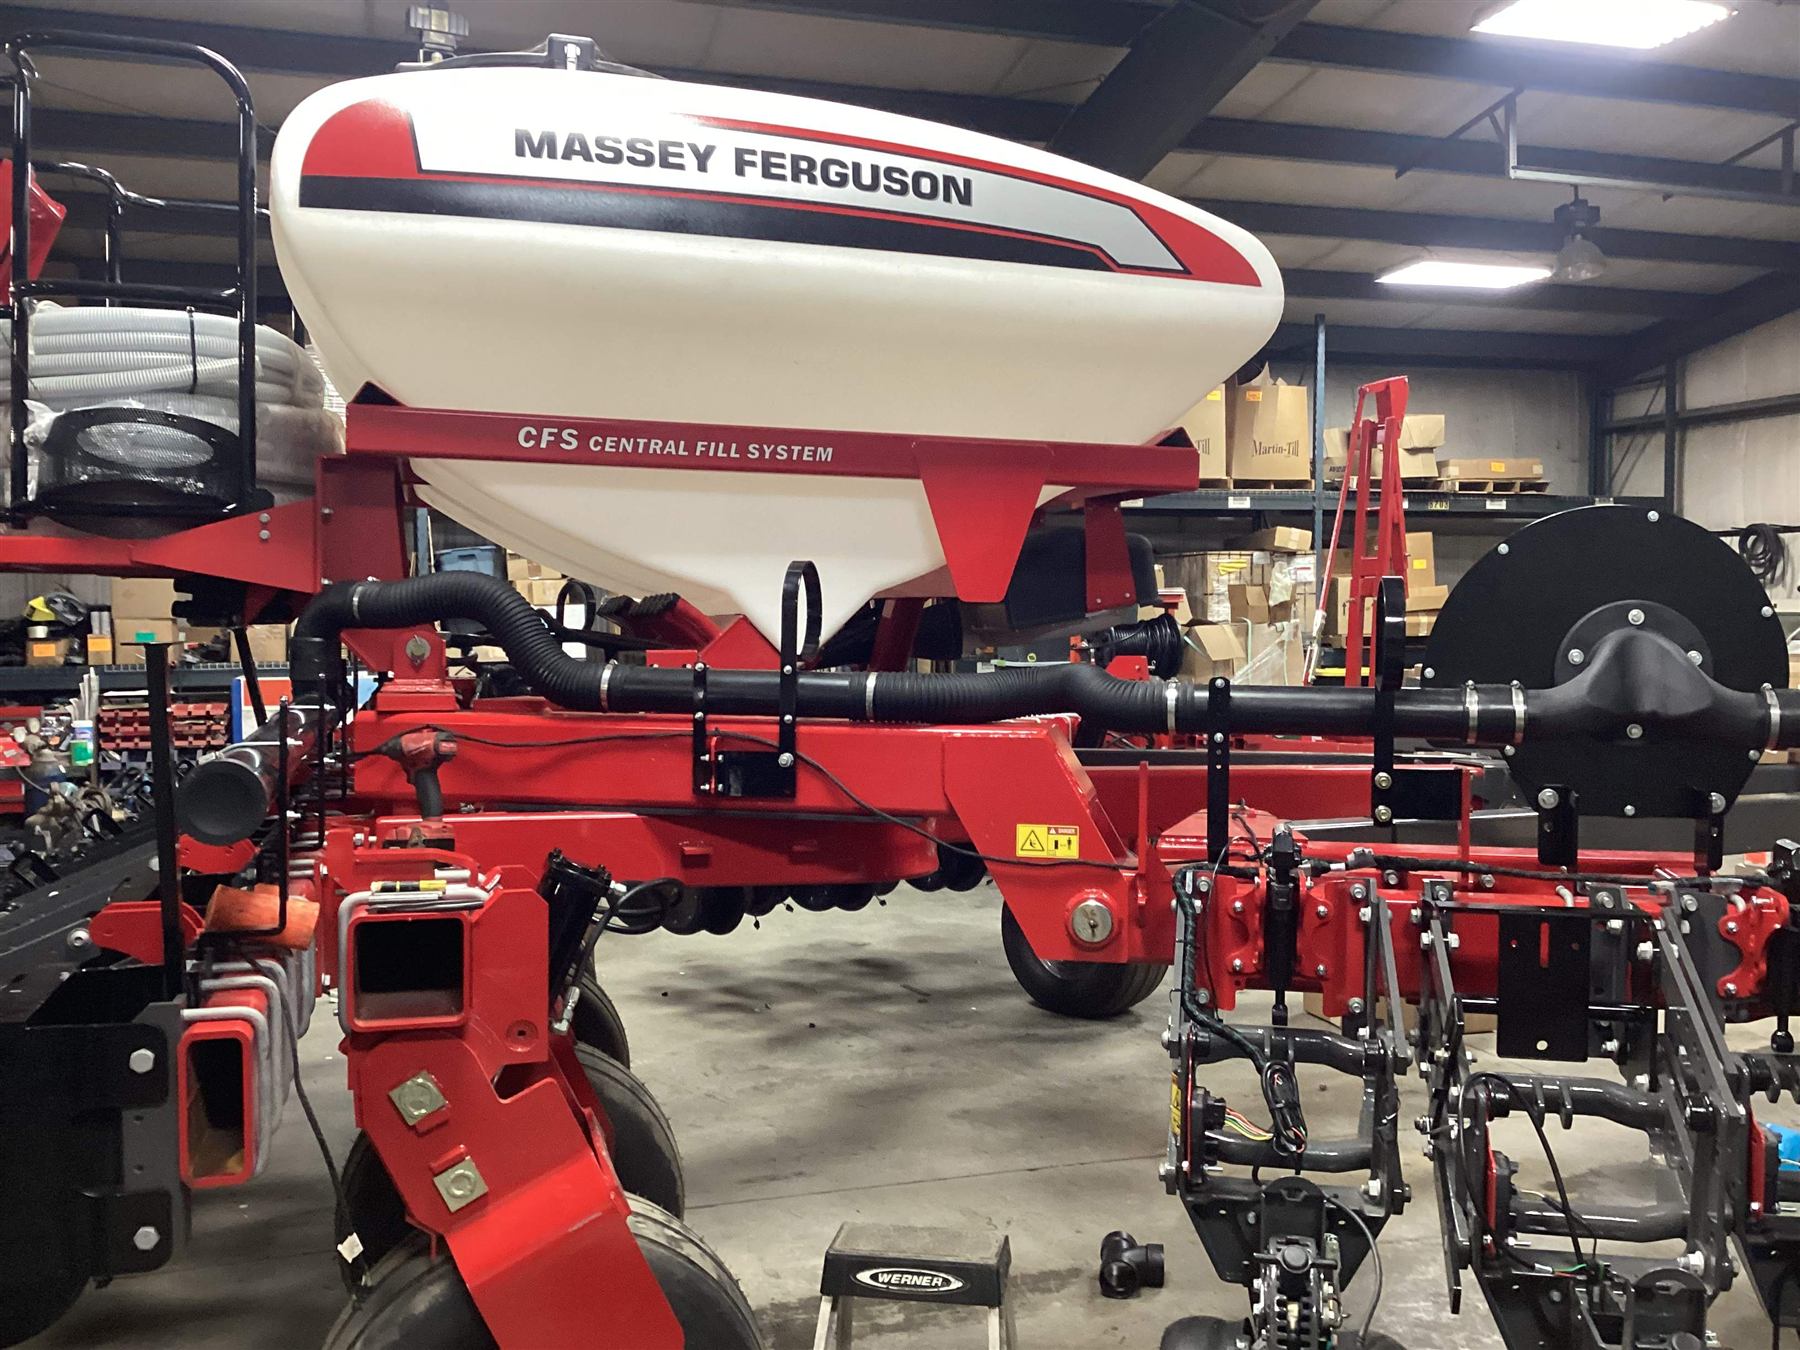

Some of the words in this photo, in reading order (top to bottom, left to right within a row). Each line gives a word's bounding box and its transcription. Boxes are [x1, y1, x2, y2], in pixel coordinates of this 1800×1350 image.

[514, 128, 717, 173] MASSEY
[734, 146, 974, 207] FERGUSON
[517, 426, 579, 450] CFS
[589, 435, 689, 456] CENTRAL
[695, 441, 741, 458] FILL
[747, 443, 834, 462] SYSTEM
[1251, 439, 1300, 458] Martin-Till
[878, 1273, 943, 1287] WERNER
